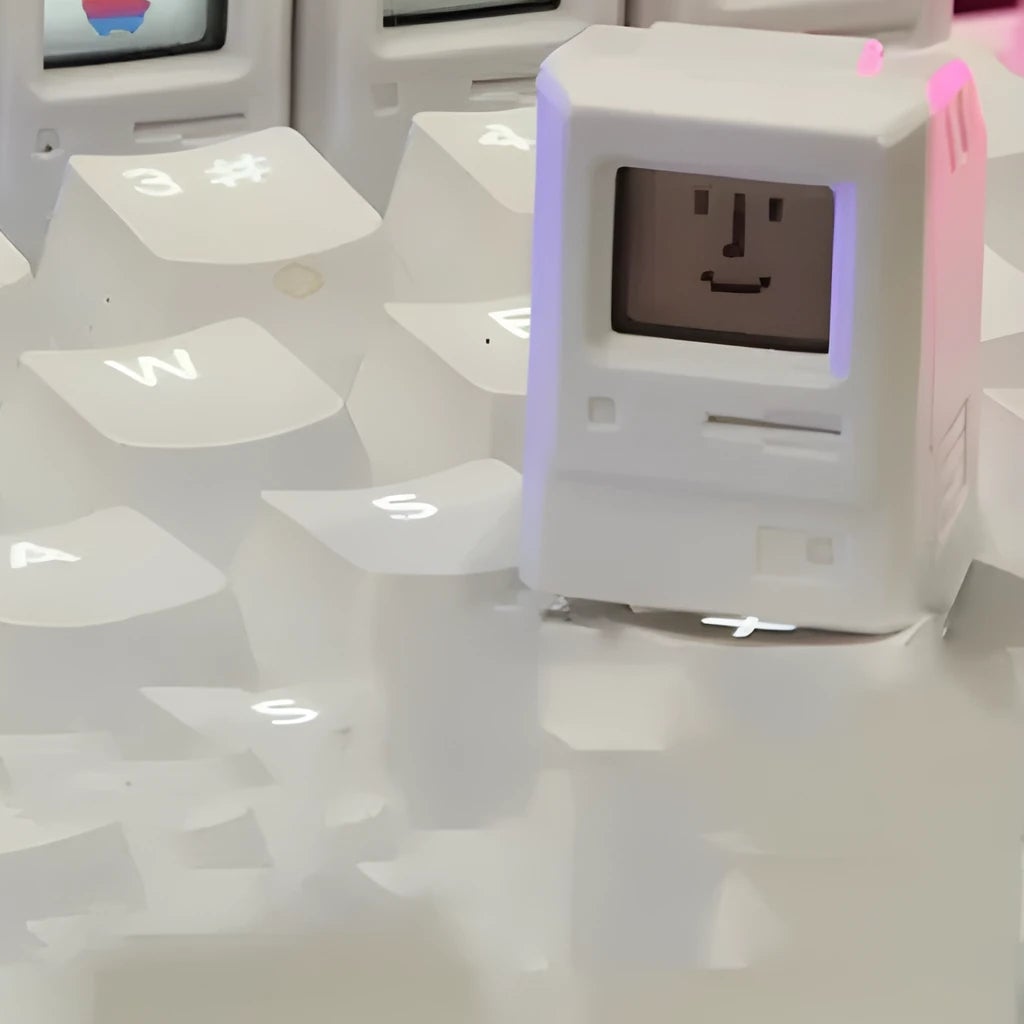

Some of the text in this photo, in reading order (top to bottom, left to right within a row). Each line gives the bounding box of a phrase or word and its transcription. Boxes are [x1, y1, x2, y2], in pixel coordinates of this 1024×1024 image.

[122, 167, 183, 197] 3
[103, 348, 198, 387] W
[371, 493, 439, 520] S
[9, 541, 82, 569] A
[251, 698, 319, 725] S
